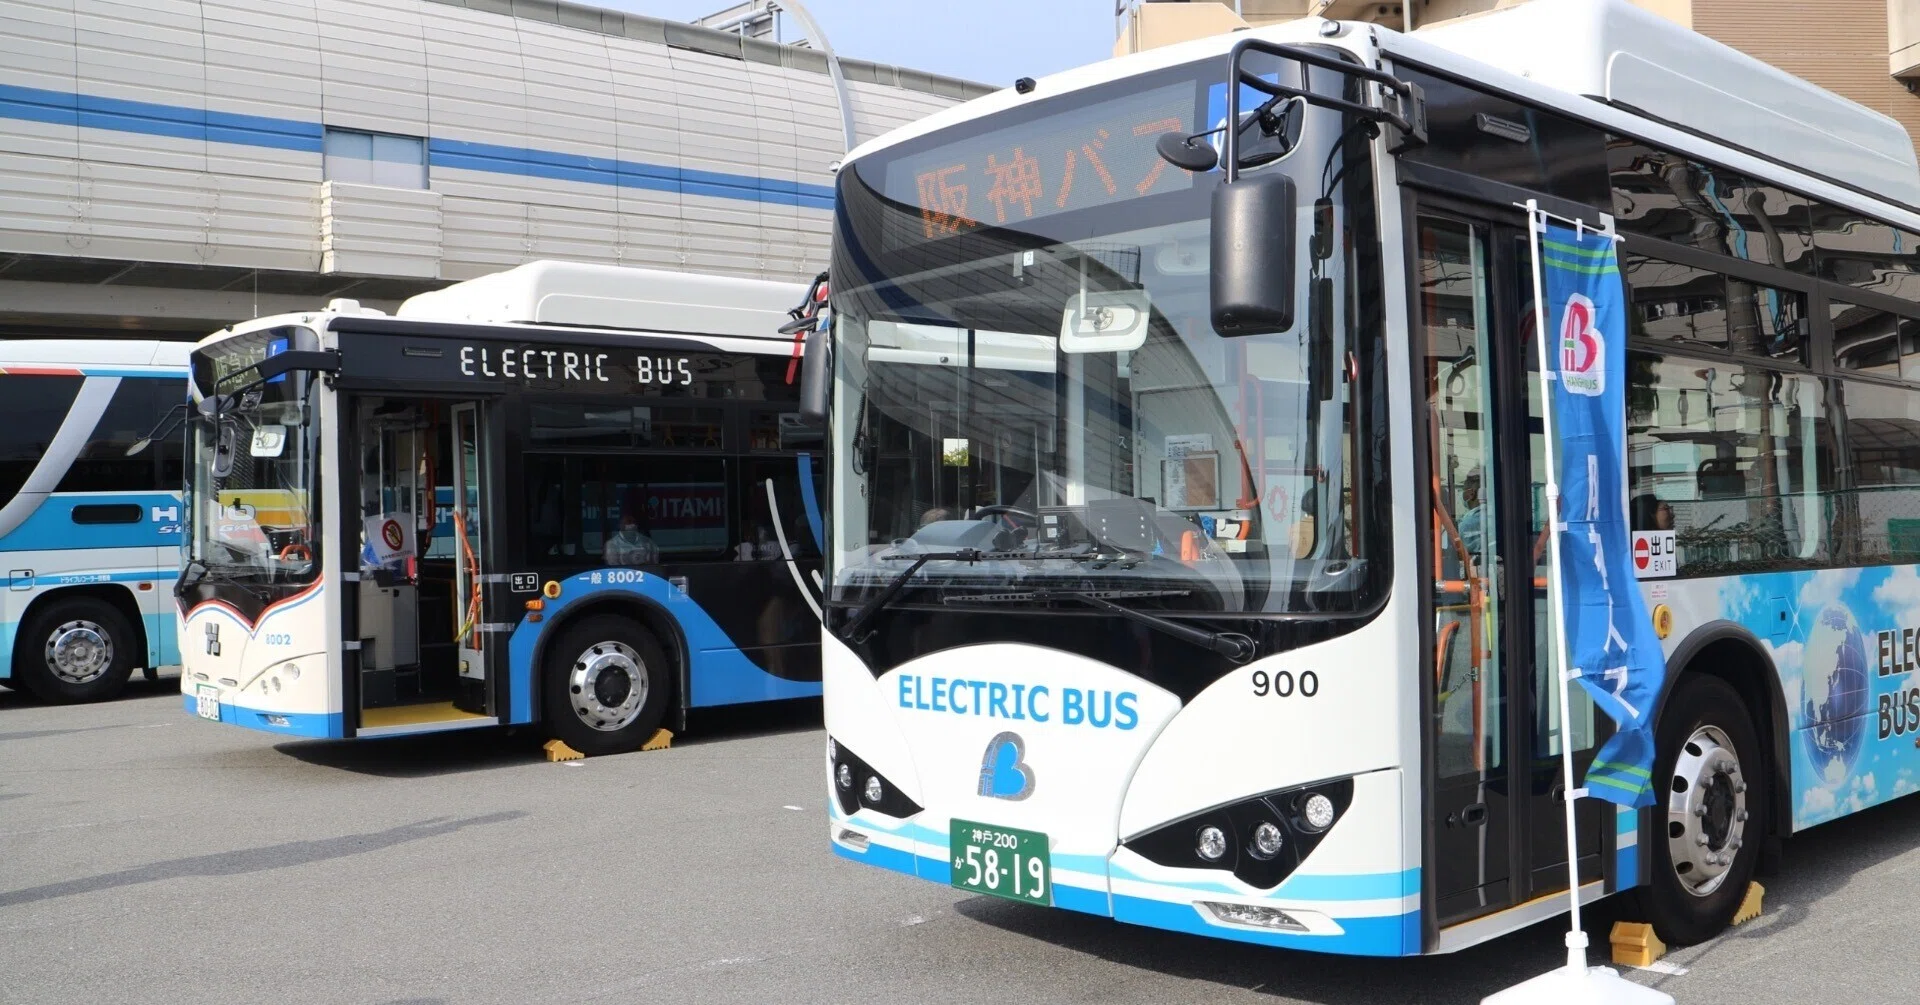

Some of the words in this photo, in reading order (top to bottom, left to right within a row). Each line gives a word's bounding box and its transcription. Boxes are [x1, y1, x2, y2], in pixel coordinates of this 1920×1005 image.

[914, 117, 1194, 240] 阪神バス
[460, 346, 609, 382] ELECTRIC
[637, 356, 692, 385] BUS
[1651, 535, 1674, 556] 出口
[579, 572, 602, 584] 一般
[607, 571, 644, 583] 8002
[1654, 560, 1672, 571] EXIT
[514, 575, 535, 585] 出口
[1252, 670, 1319, 698] 900
[898, 674, 1050, 723] ELECTRIC
[1062, 688, 1139, 731] BUS
[1879, 688, 1920, 739] BUS
[972, 829, 1018, 850] 神戸200
[966, 845, 1045, 899] 58-19
